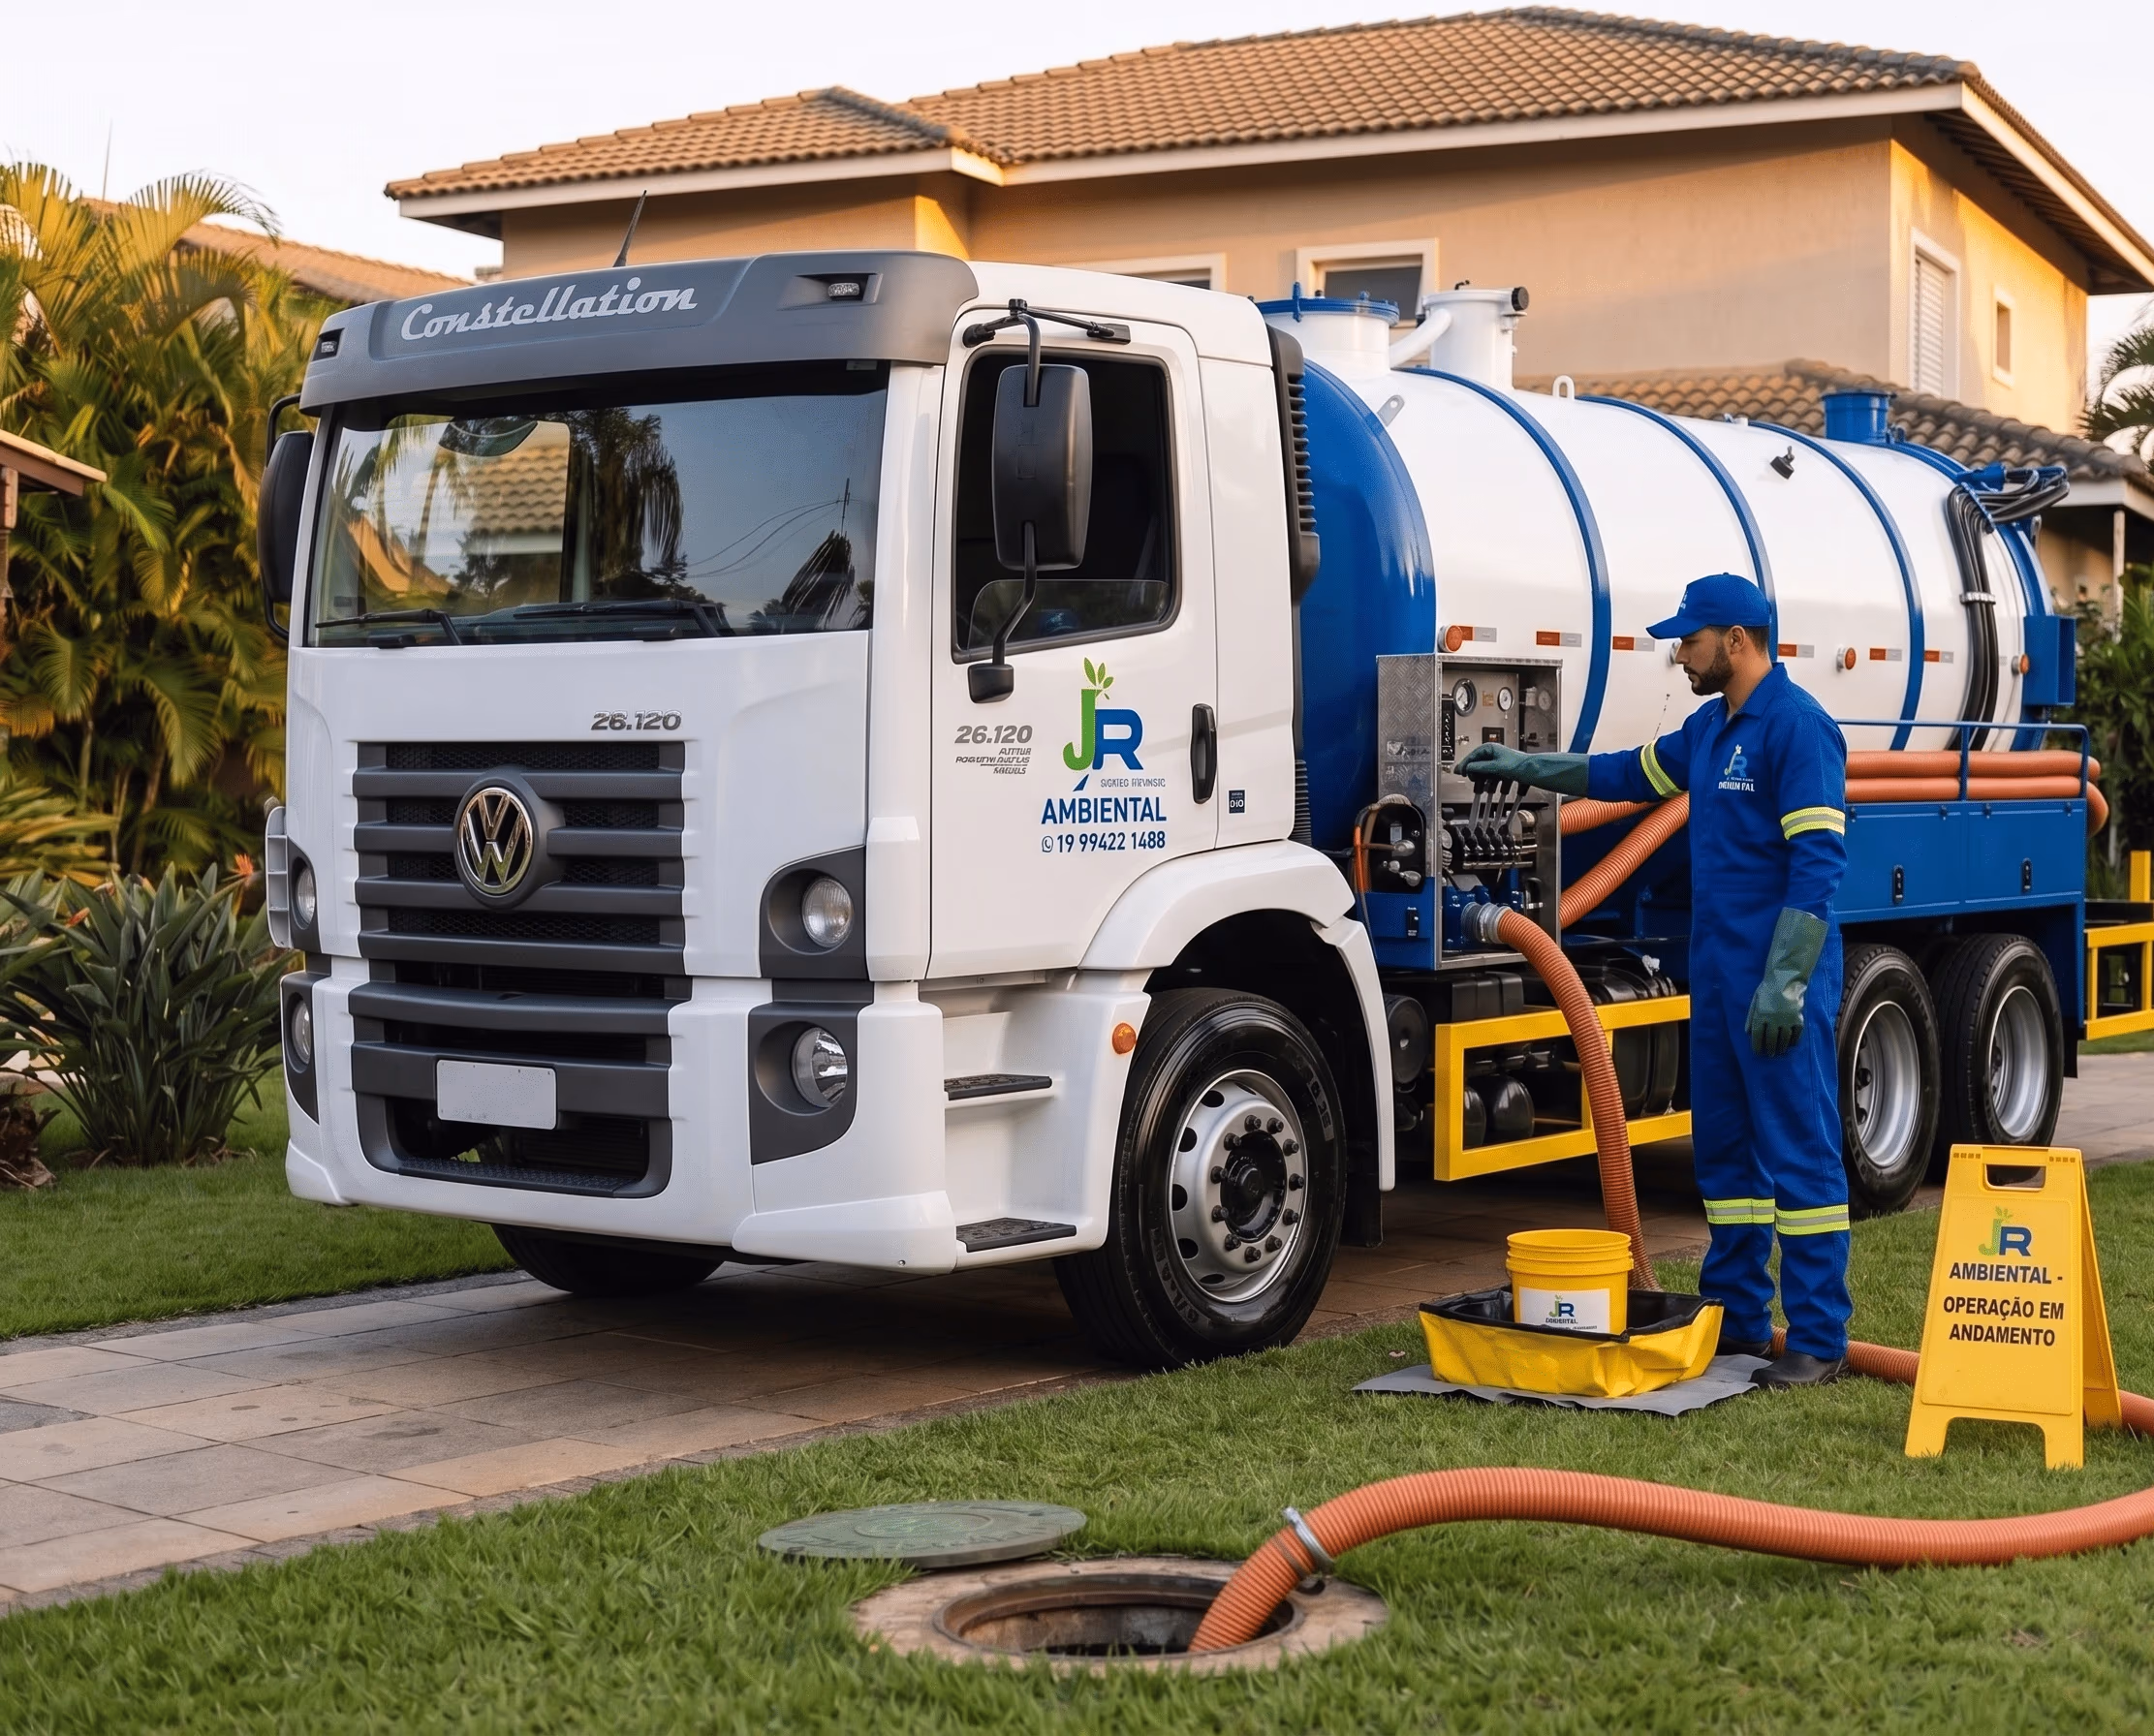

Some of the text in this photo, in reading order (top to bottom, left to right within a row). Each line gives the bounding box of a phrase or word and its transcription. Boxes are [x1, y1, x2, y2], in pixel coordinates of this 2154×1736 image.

[400, 276, 698, 341] Constellation
[590, 710, 682, 730] 26.120
[1062, 688, 1144, 772] JR
[953, 725, 1033, 744] 26.120
[1041, 796, 1168, 824] AMBIENTAL
[1056, 830, 1166, 853] 19 99422 1488
[1978, 1218, 2032, 1256] JR
[1949, 1262, 2052, 1285] AMBIENTAL
[1548, 1300, 1576, 1317] JR
[1943, 1296, 2065, 1320] OPERAÇÃO EM
[1949, 1323, 2055, 1347] ANDAMENTO
